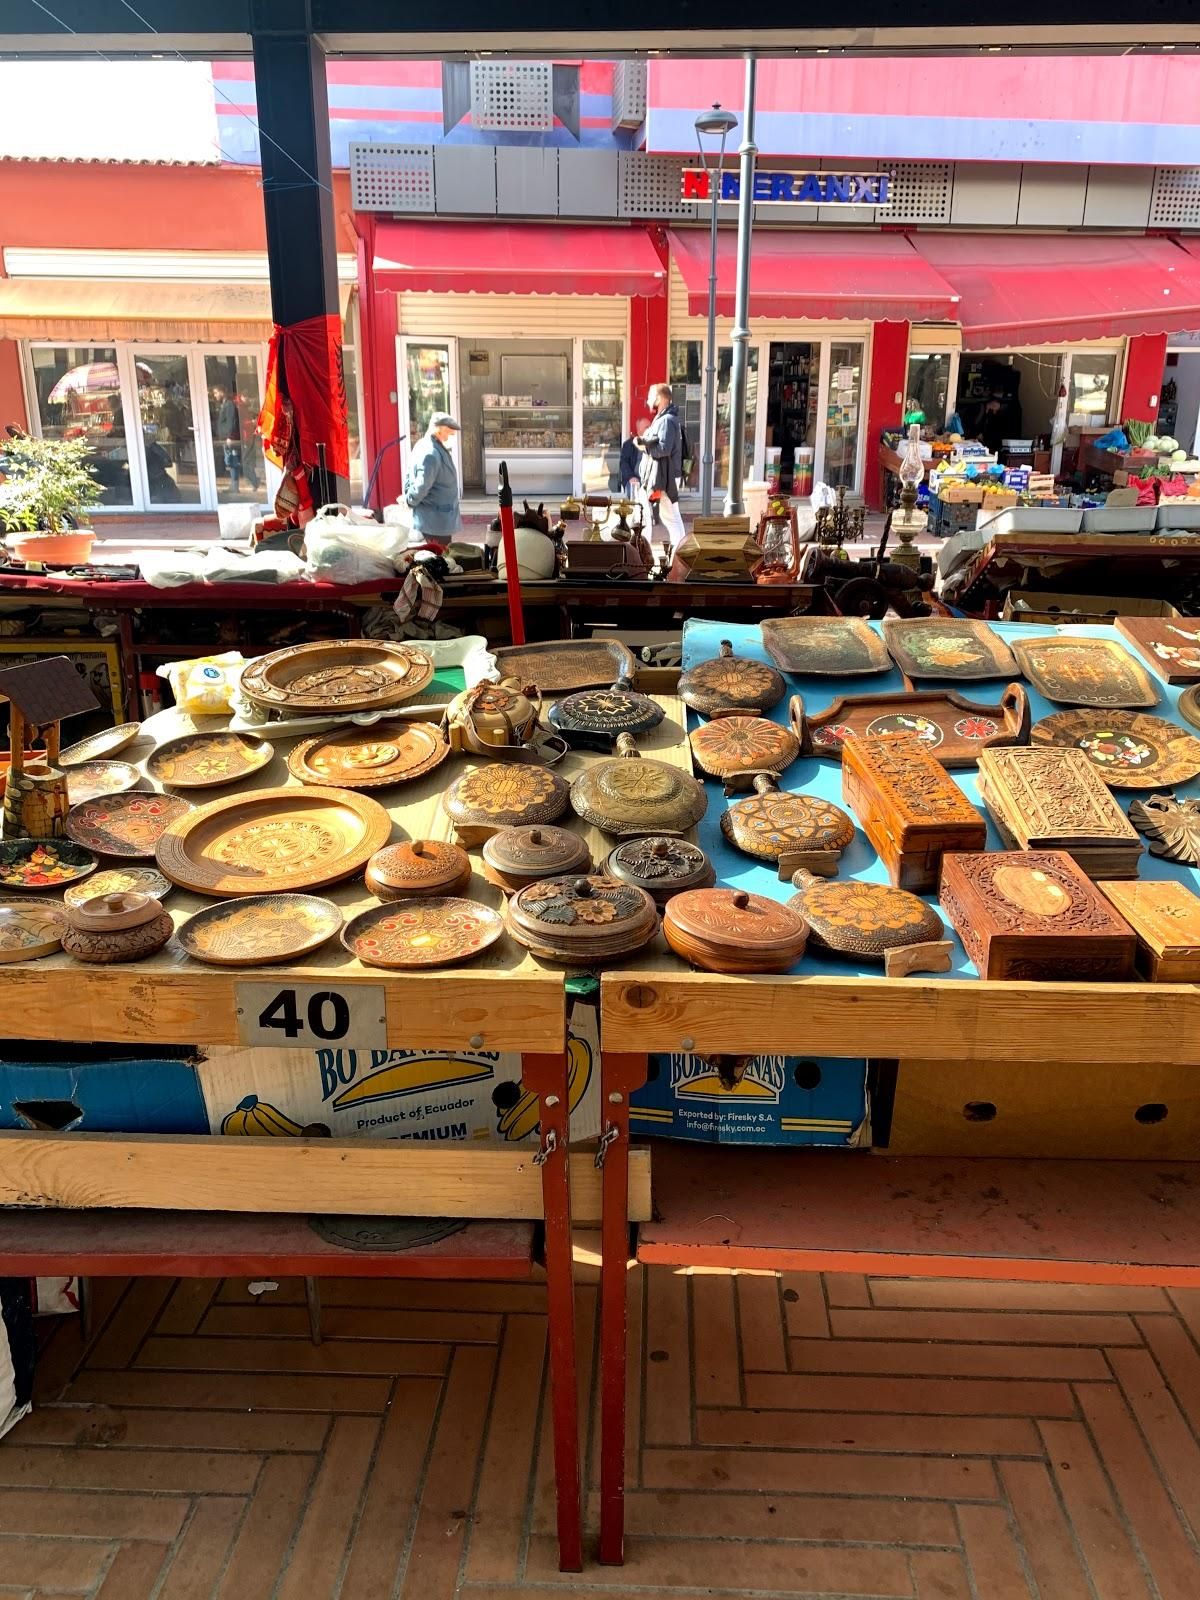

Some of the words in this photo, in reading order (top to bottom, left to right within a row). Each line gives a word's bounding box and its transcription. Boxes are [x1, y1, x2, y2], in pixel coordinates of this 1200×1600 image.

[258, 989, 350, 1040] 40
[357, 1111, 406, 1129] Product
[409, 1107, 422, 1117] of
[425, 1099, 475, 1114] Ecuador
[679, 1109, 713, 1119] Exported
[714, 1113, 726, 1122] by:
[728, 1113, 757, 1123] Firesky
[758, 1114, 775, 1122] S.A.
[686, 1120, 766, 1133] info@firesky.com.ec
